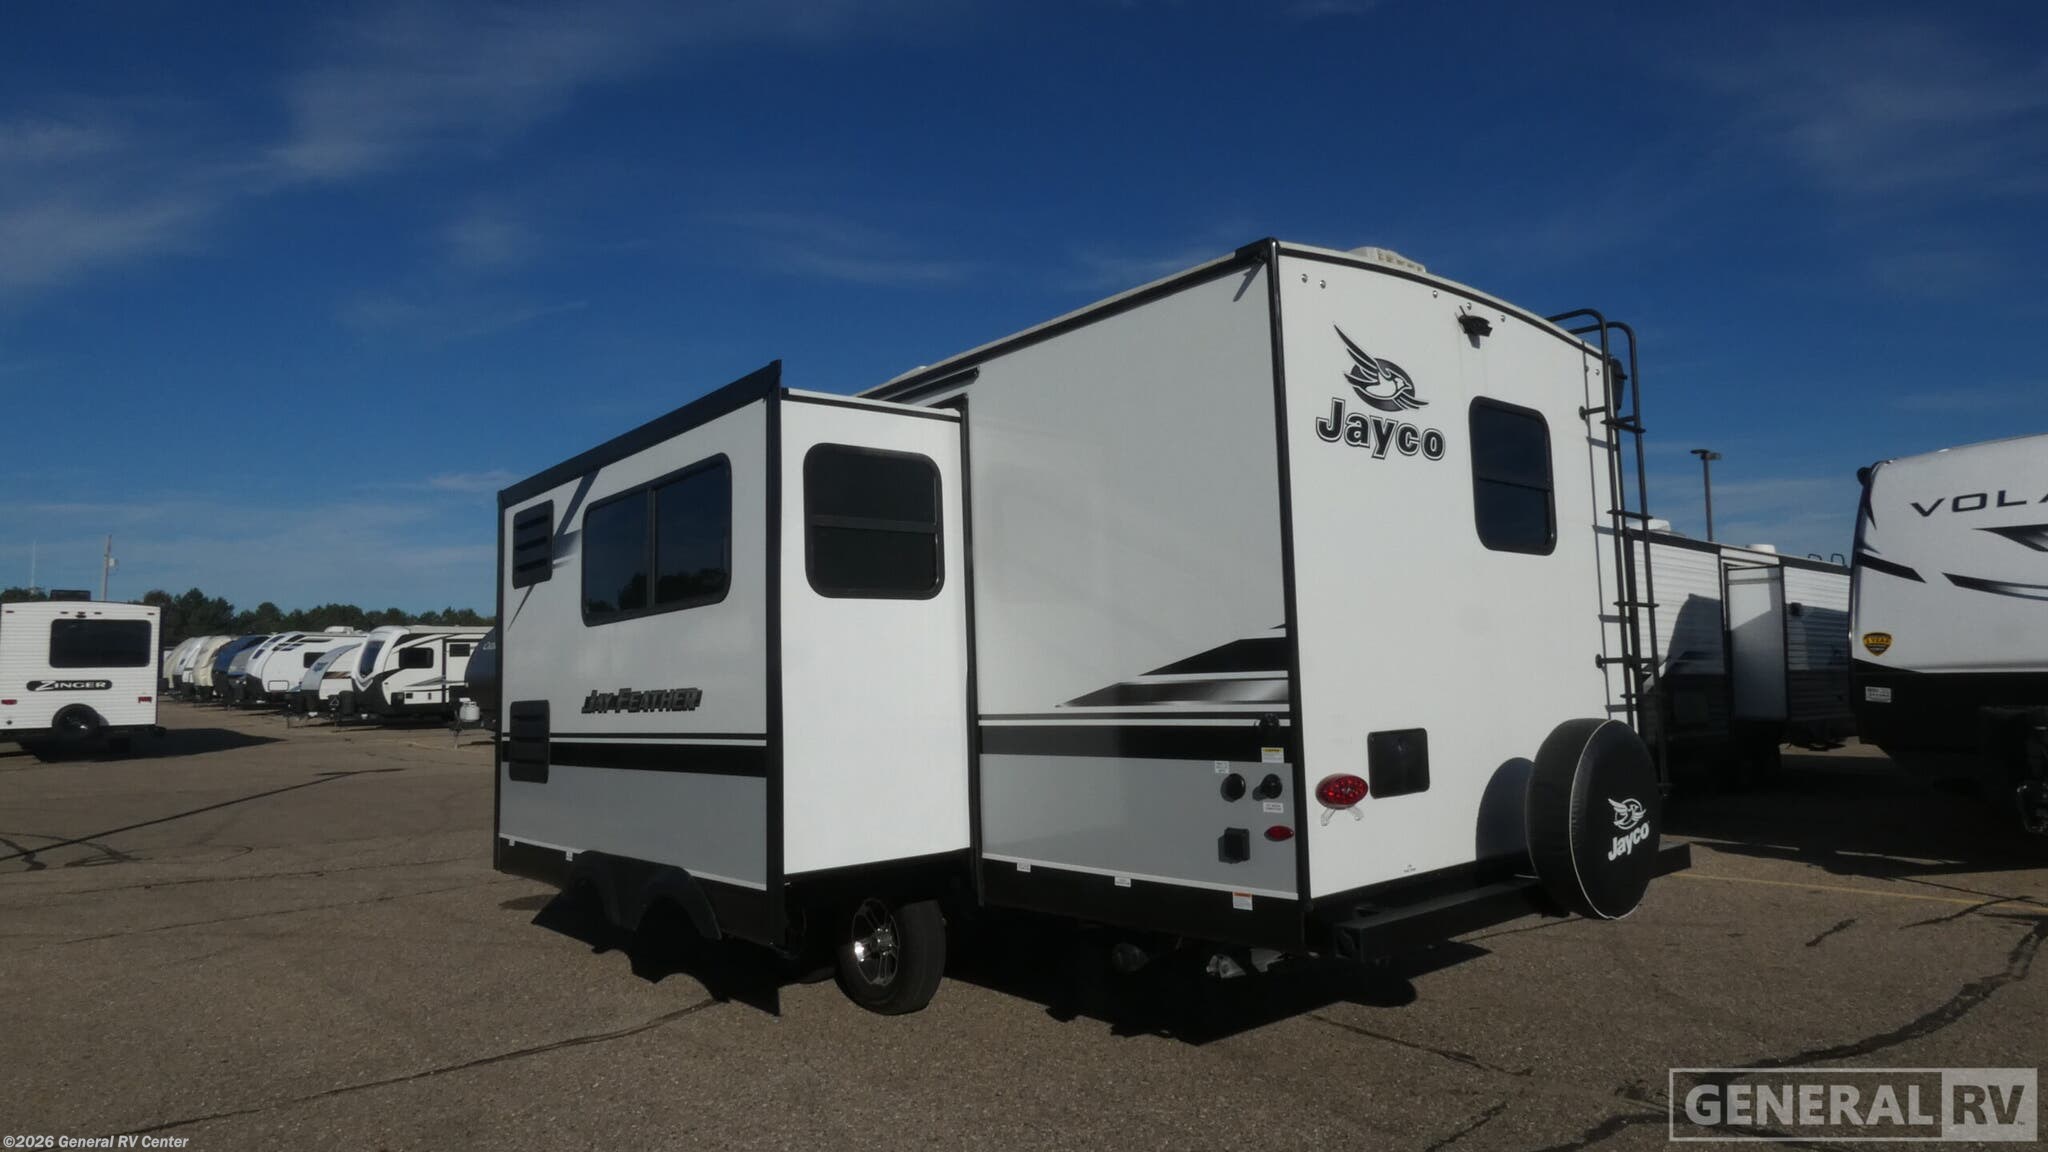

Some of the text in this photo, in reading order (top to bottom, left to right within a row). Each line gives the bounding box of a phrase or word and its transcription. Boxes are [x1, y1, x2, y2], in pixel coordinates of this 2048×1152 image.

[1315, 397, 1446, 461] Jayco
[1910, 490, 2048, 517] VOL
[35, 680, 106, 691] ZINGER
[615, 687, 703, 713] FEATHER
[1608, 822, 1650, 861] Jayco
